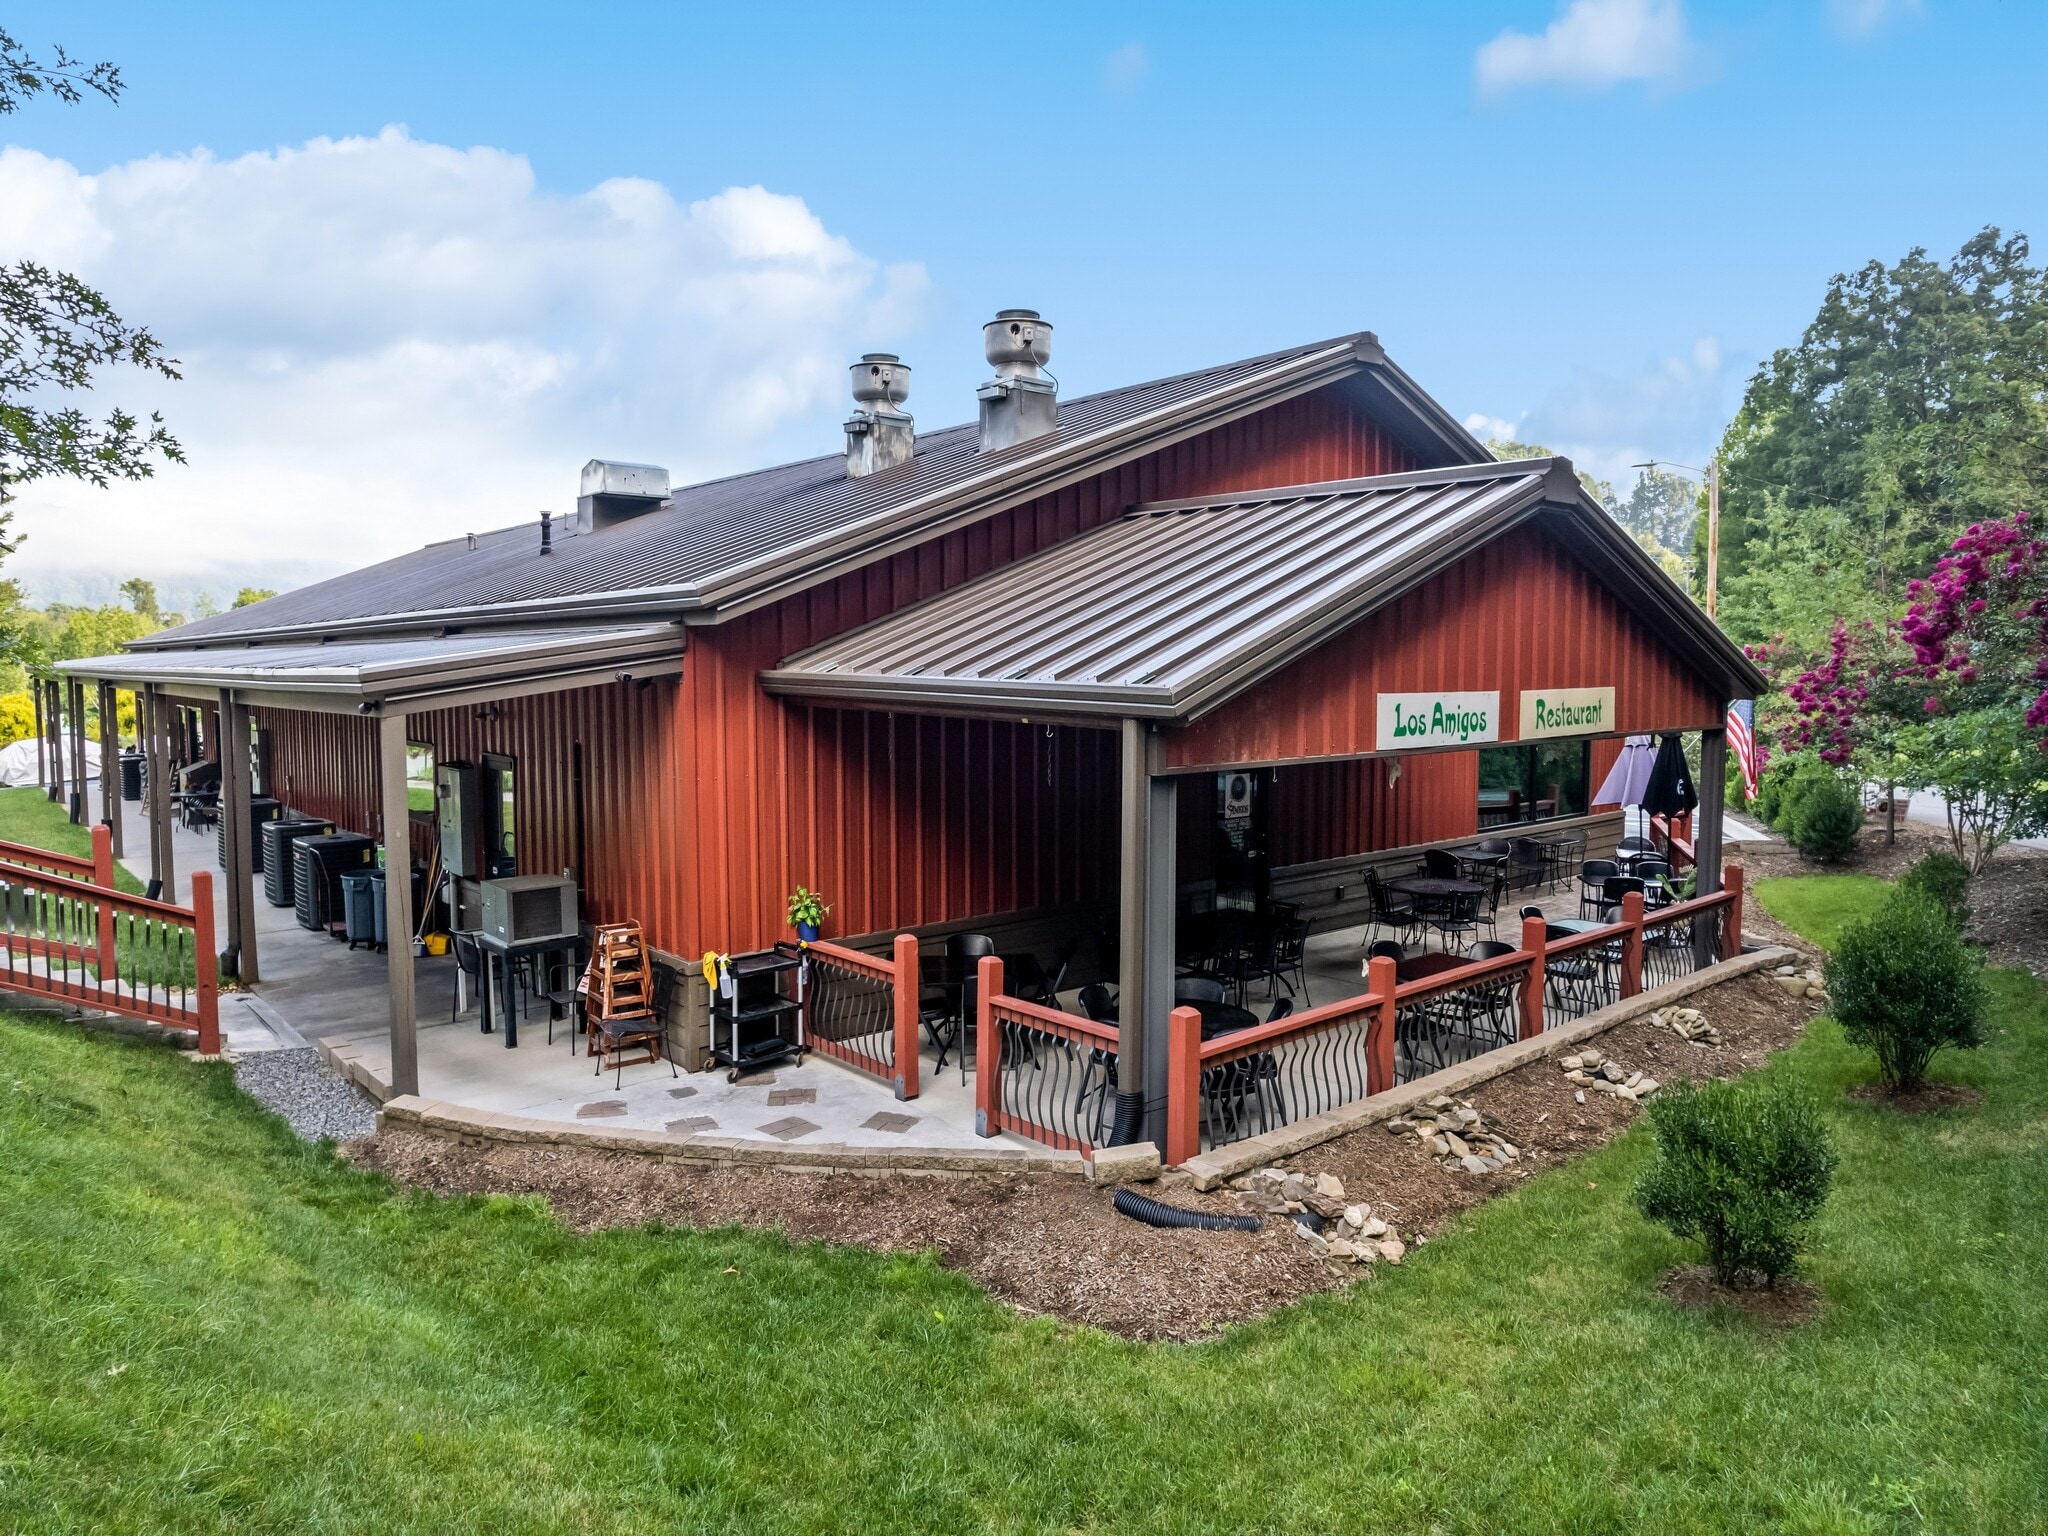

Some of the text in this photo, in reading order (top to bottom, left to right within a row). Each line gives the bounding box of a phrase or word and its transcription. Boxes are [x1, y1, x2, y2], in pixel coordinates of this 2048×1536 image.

[1394, 702, 1487, 741] Los Amigos
[1536, 698, 1602, 730] Restaurant
